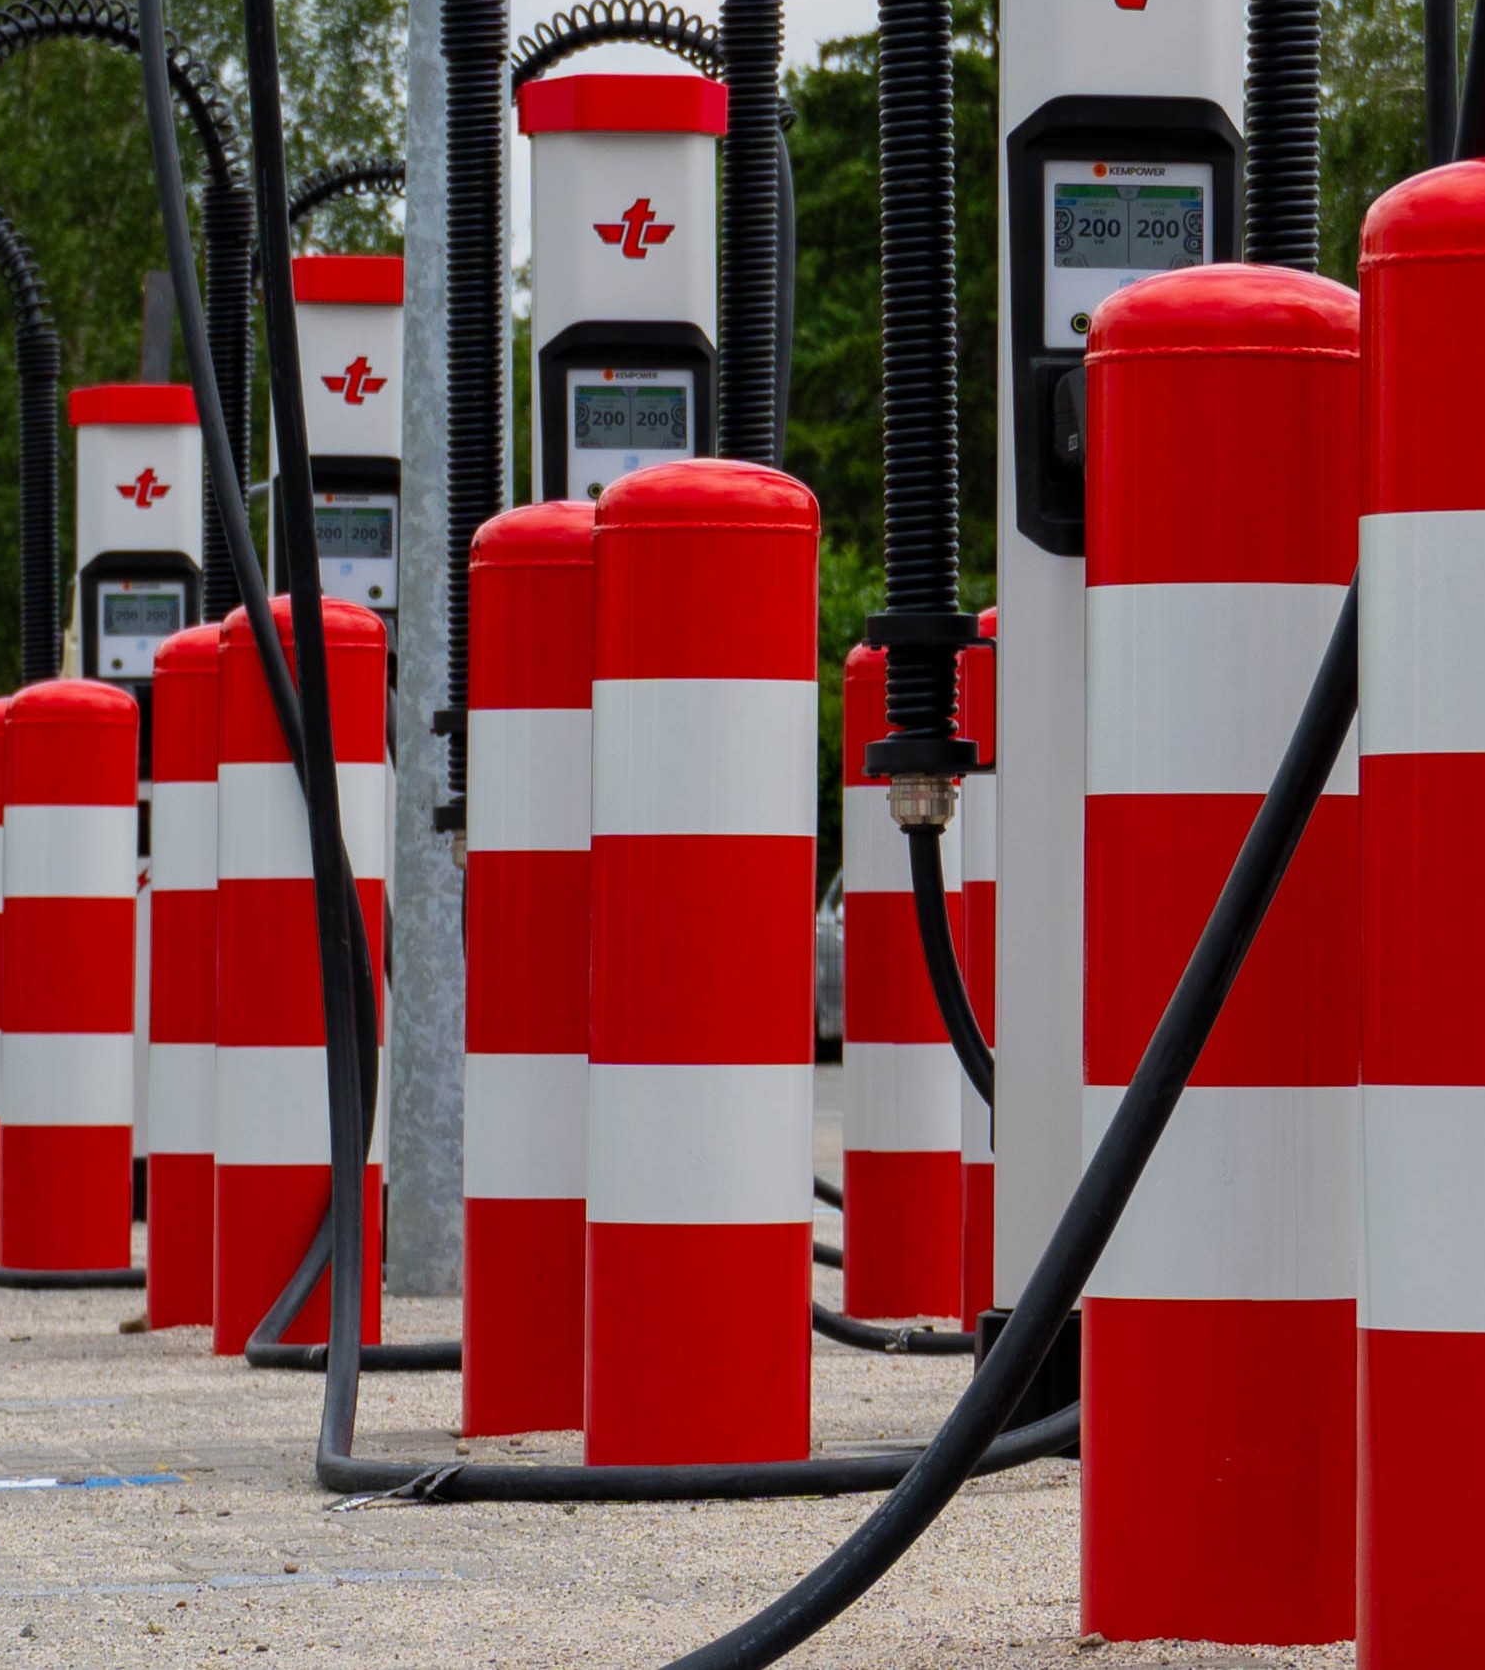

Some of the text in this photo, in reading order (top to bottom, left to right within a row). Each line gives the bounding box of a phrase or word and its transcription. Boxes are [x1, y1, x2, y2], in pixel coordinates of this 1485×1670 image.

[1109, 166, 1165, 176] KEMPOWER
[1078, 218, 1121, 238] 200
[1137, 219, 1180, 239] 200
[615, 372, 658, 380] KEMPOWER
[592, 411, 625, 427] 200
[636, 411, 669, 427] 200
[317, 527, 342, 540] 200
[351, 527, 377, 540] 200
